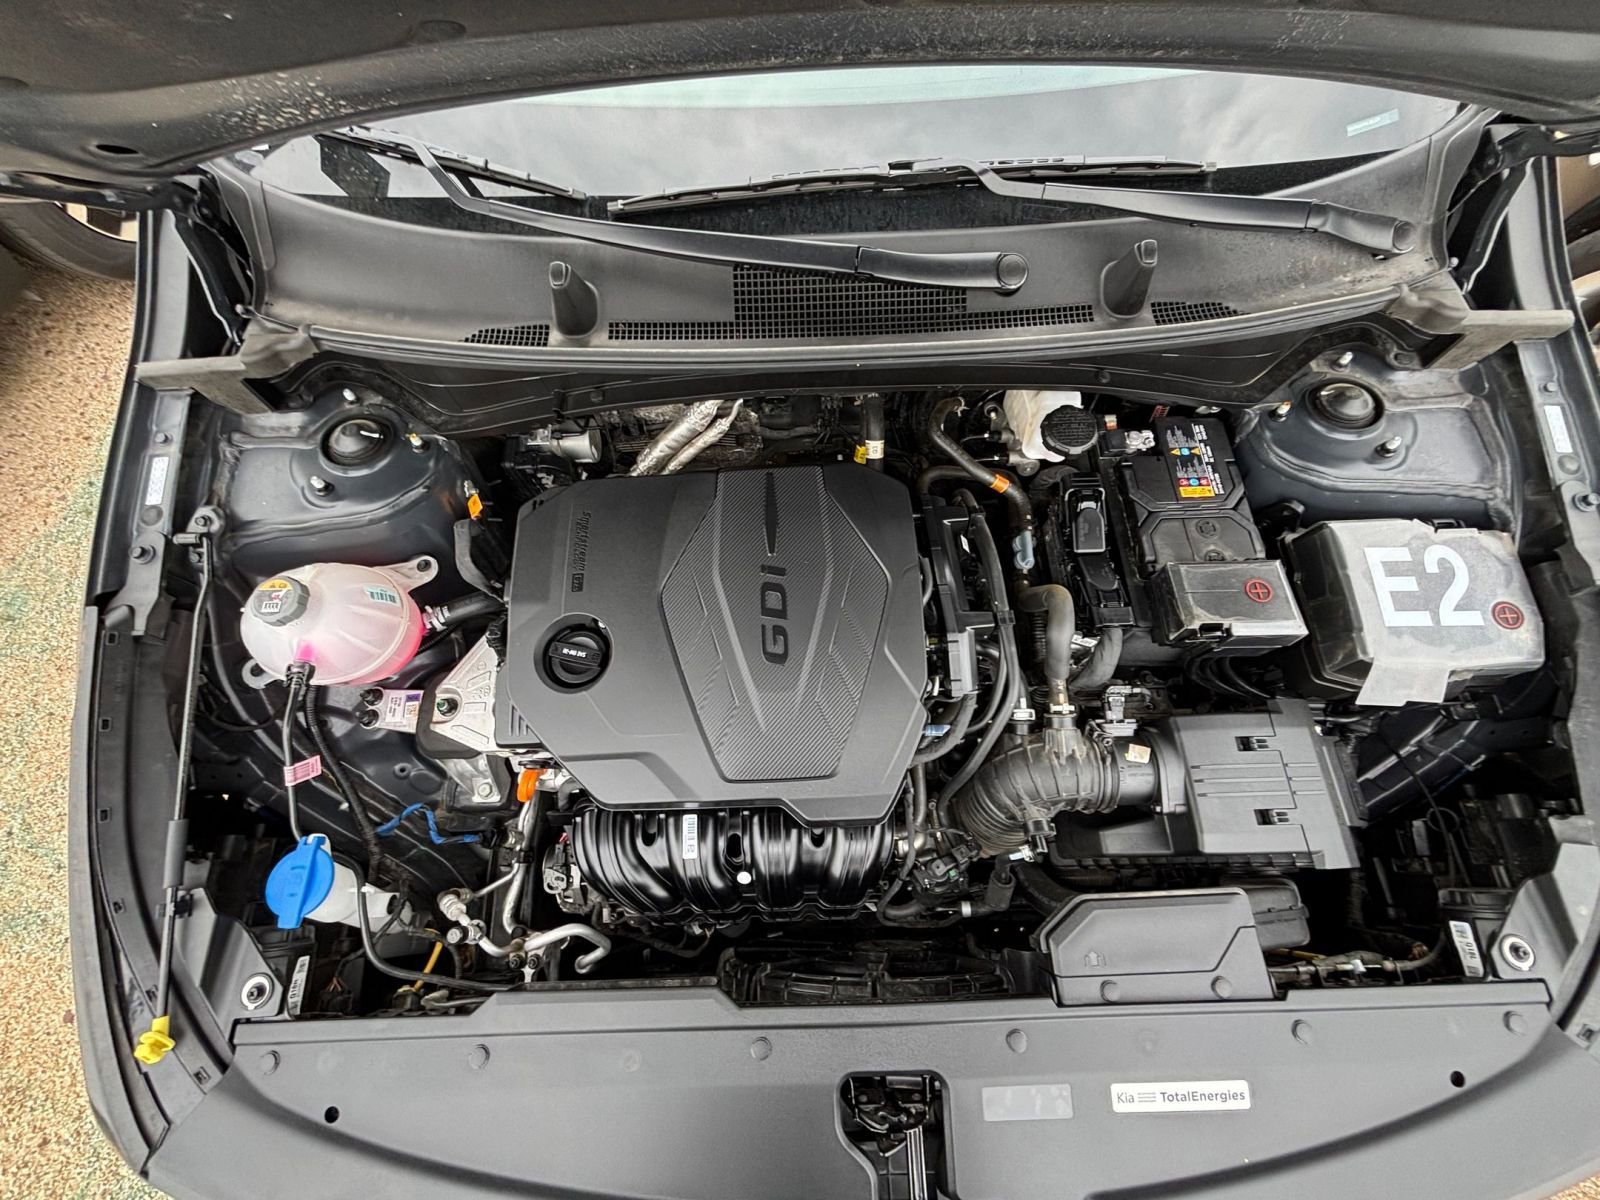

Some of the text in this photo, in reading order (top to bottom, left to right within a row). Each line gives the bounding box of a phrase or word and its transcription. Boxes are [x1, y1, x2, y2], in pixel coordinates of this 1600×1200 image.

[578, 511, 592, 572] Smartstream
[1363, 544, 1485, 627] E2
[1116, 1089, 1246, 1104] Kia TotalEnergies
